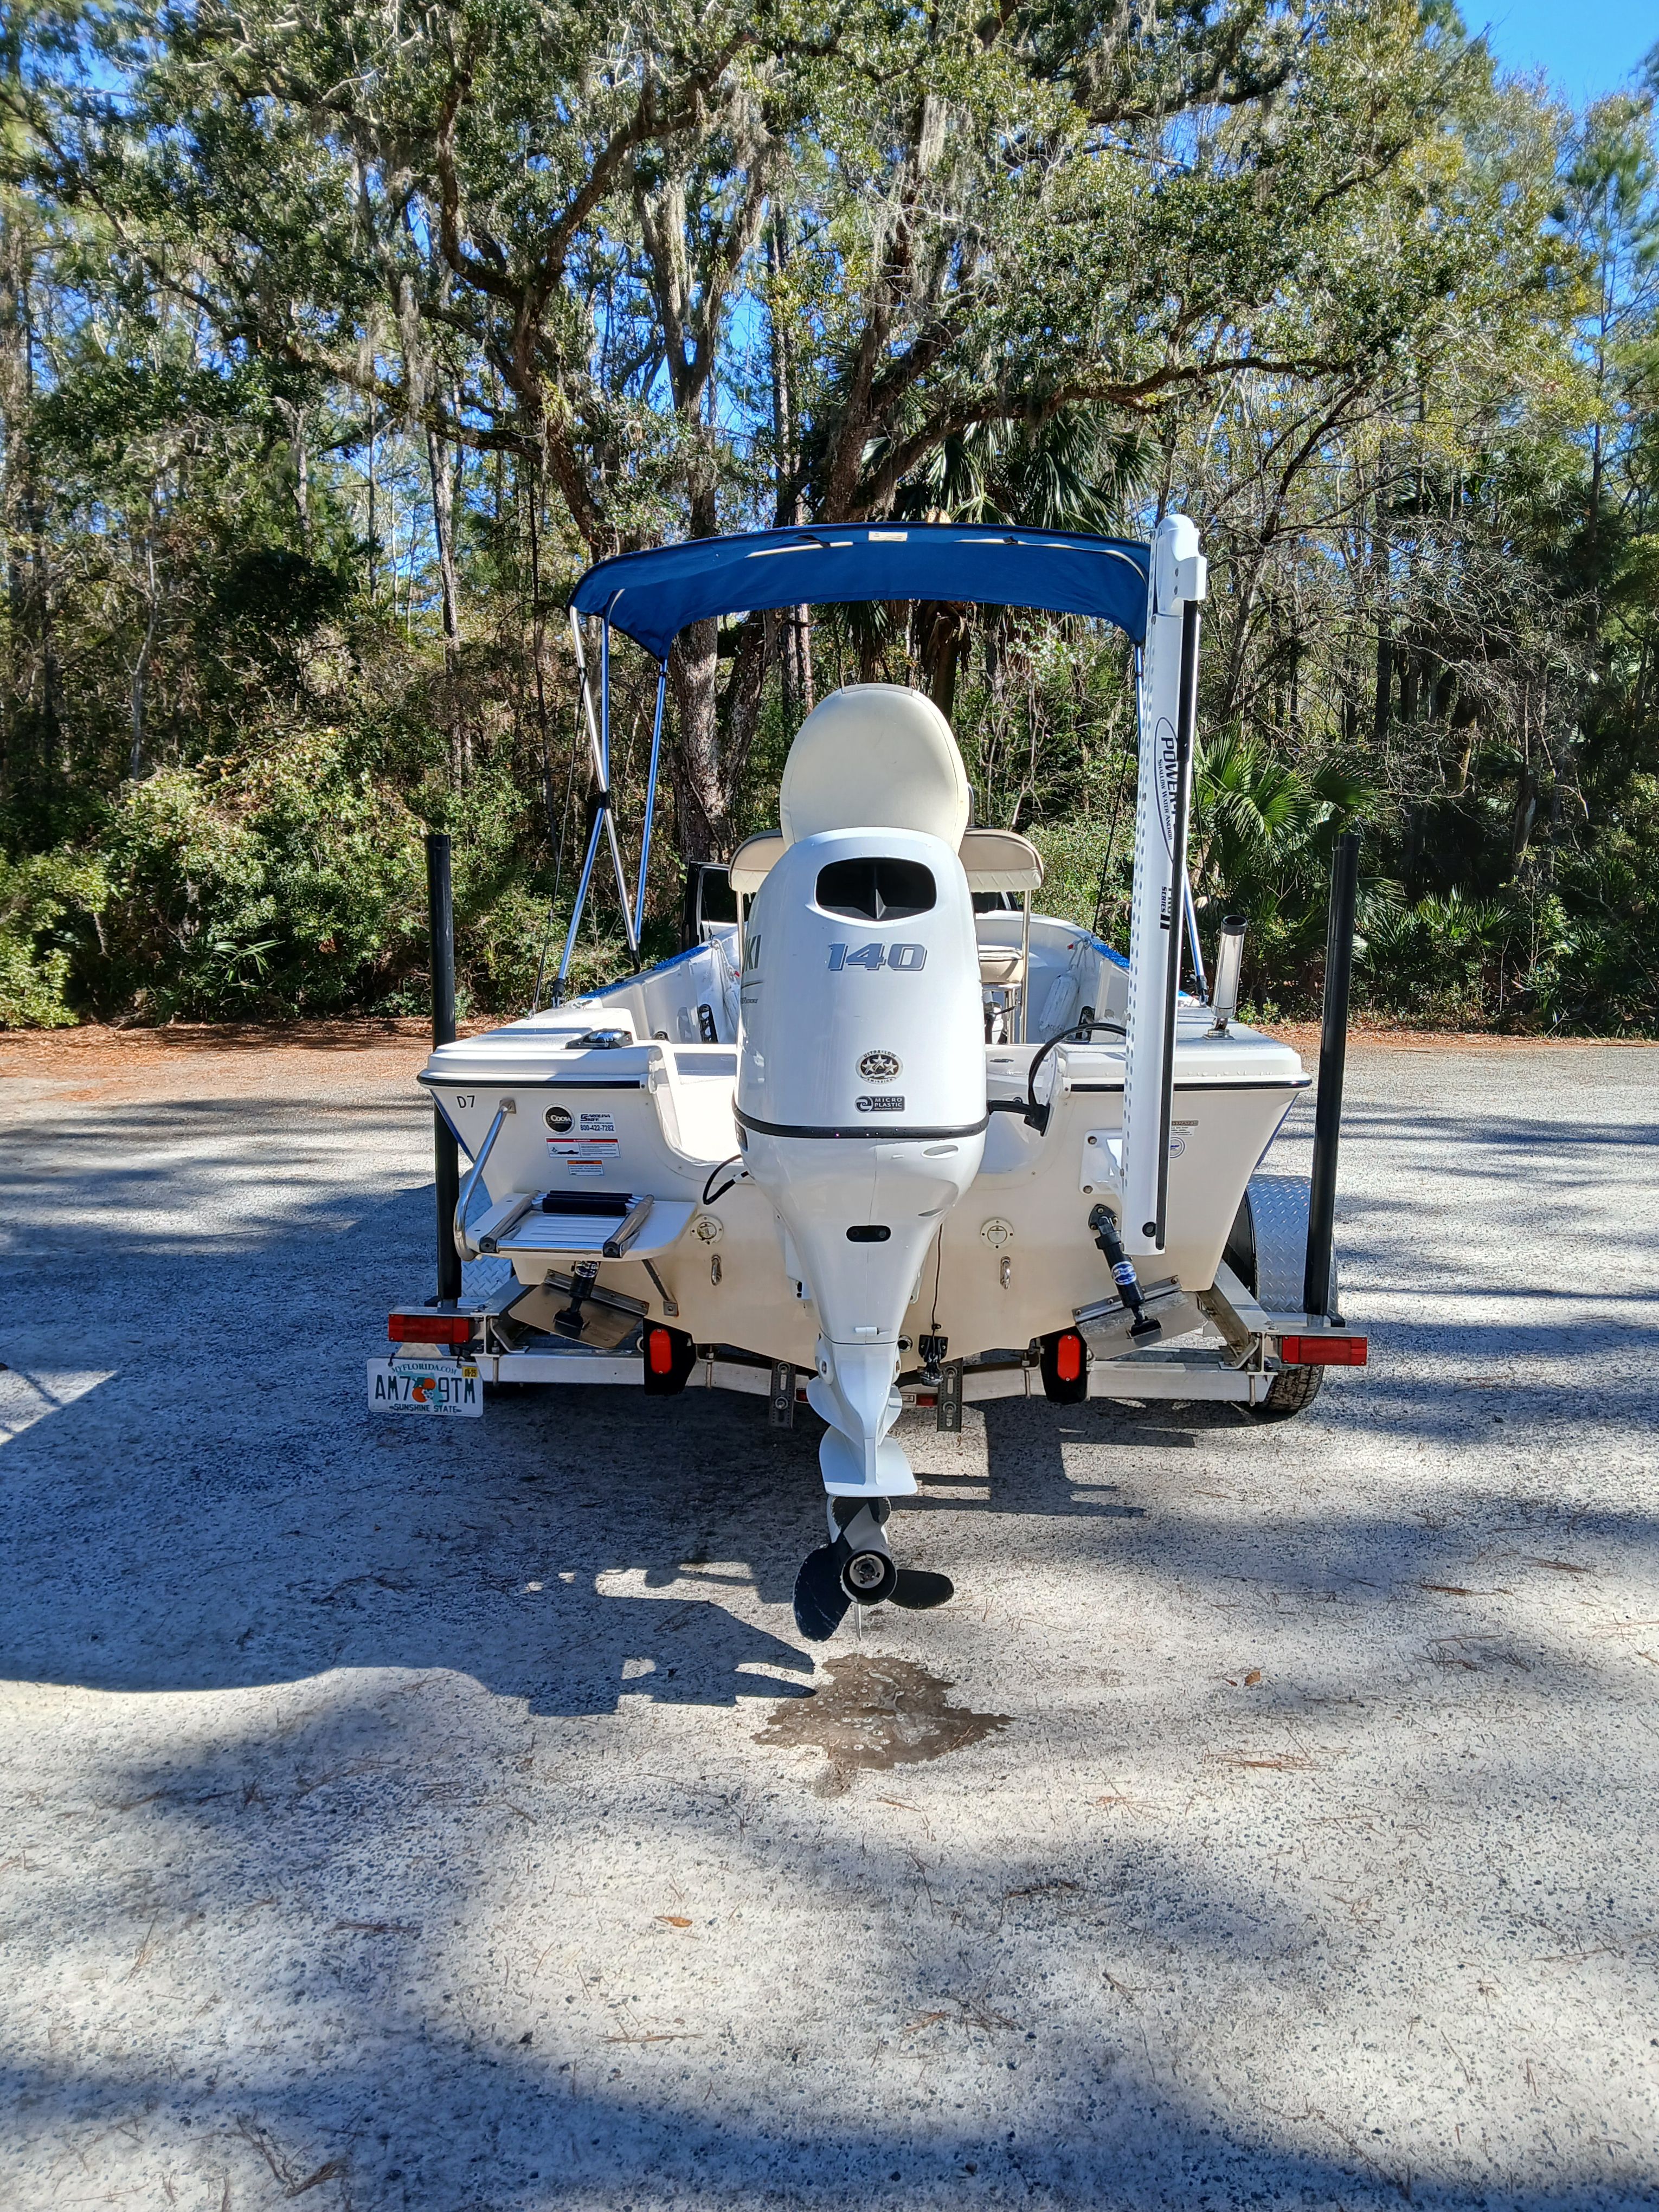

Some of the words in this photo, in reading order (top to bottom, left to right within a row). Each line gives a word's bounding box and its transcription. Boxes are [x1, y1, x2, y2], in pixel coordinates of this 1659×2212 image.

[1158, 758, 1166, 790] SHALLOW
[827, 942, 929, 971] 140
[456, 1095, 475, 1108] D7
[391, 1362, 458, 1375] MYFLORIDA.COM
[375, 1374, 410, 1400] AM7
[438, 1377, 475, 1404] 9TM
[394, 1403, 430, 1413] SUNSHINE
[433, 1405, 458, 1413] STATE
